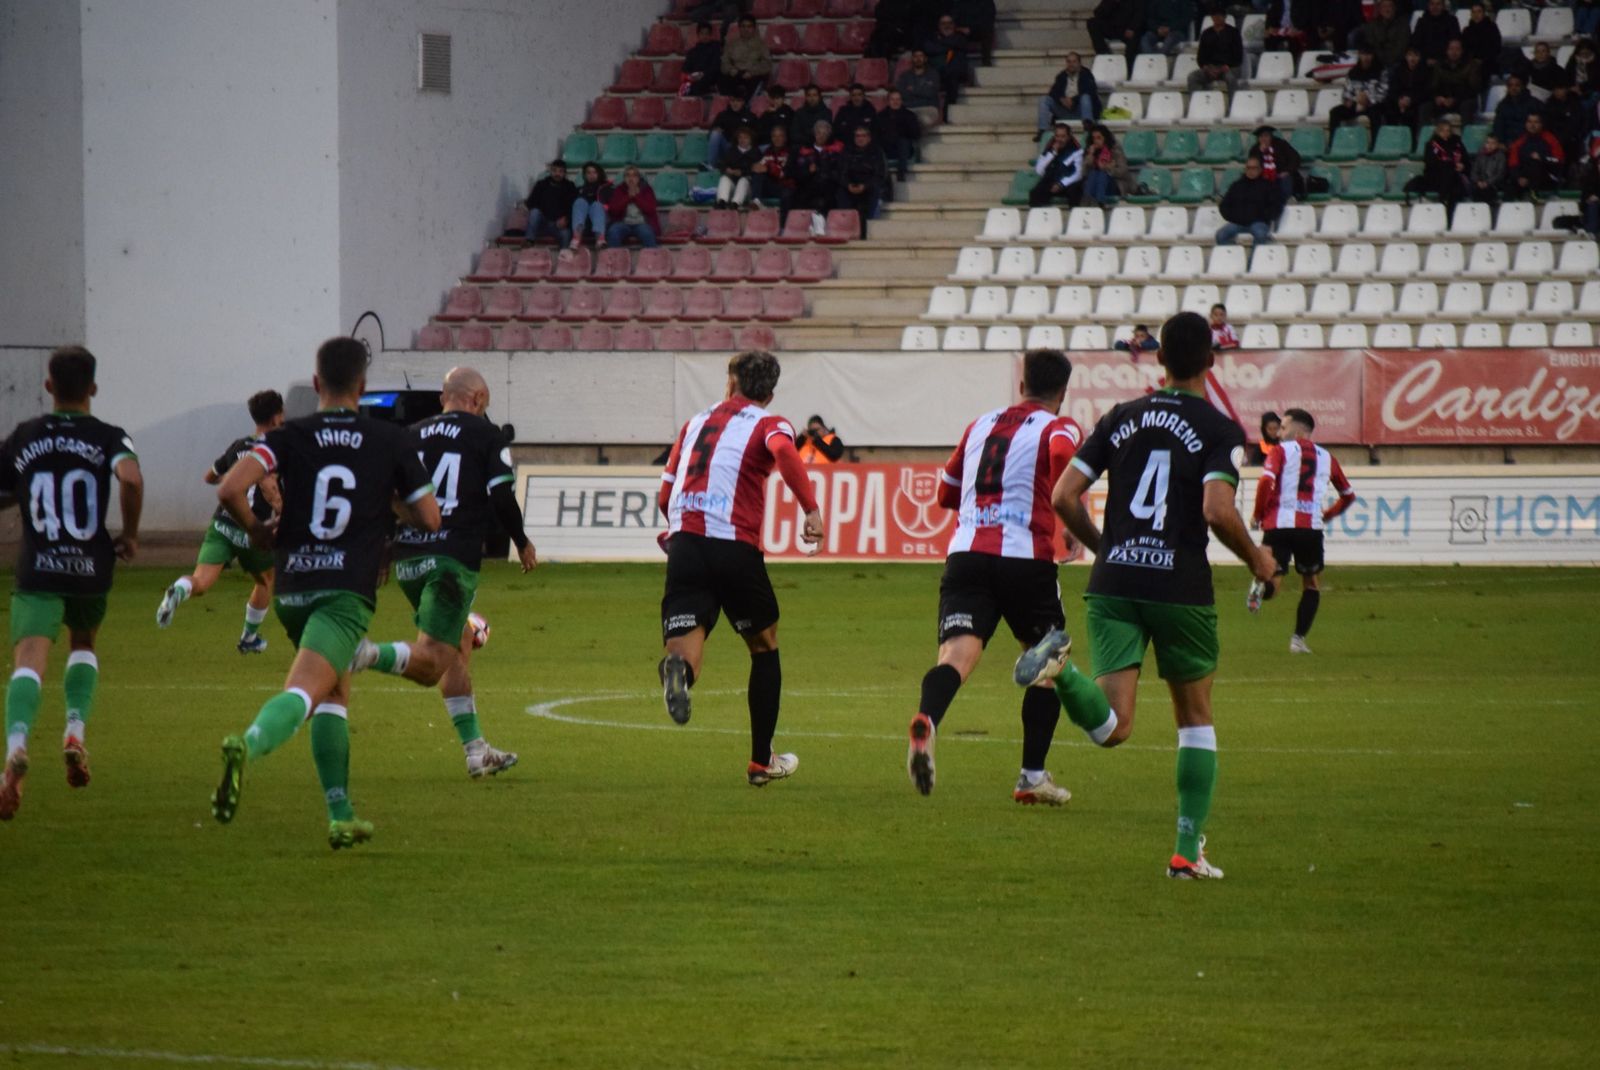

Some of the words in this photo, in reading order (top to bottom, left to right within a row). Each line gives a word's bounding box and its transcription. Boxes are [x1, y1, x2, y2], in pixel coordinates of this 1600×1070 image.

[420, 421, 462, 439] EKAIN
[1110, 419, 1138, 448] POL
[1141, 410, 1203, 453] MORENO
[14, 437, 53, 474] MARIO
[1129, 449, 1171, 531] 4
[1298, 458, 1316, 493] 2
[30, 468, 98, 541] 40
[309, 464, 357, 540] 6
[763, 470, 887, 554] COPA
[1495, 494, 1600, 536] HGM
[35, 553, 96, 576] PASTOR
[902, 543, 940, 555] DEL
[1107, 547, 1175, 567] PASTOR
